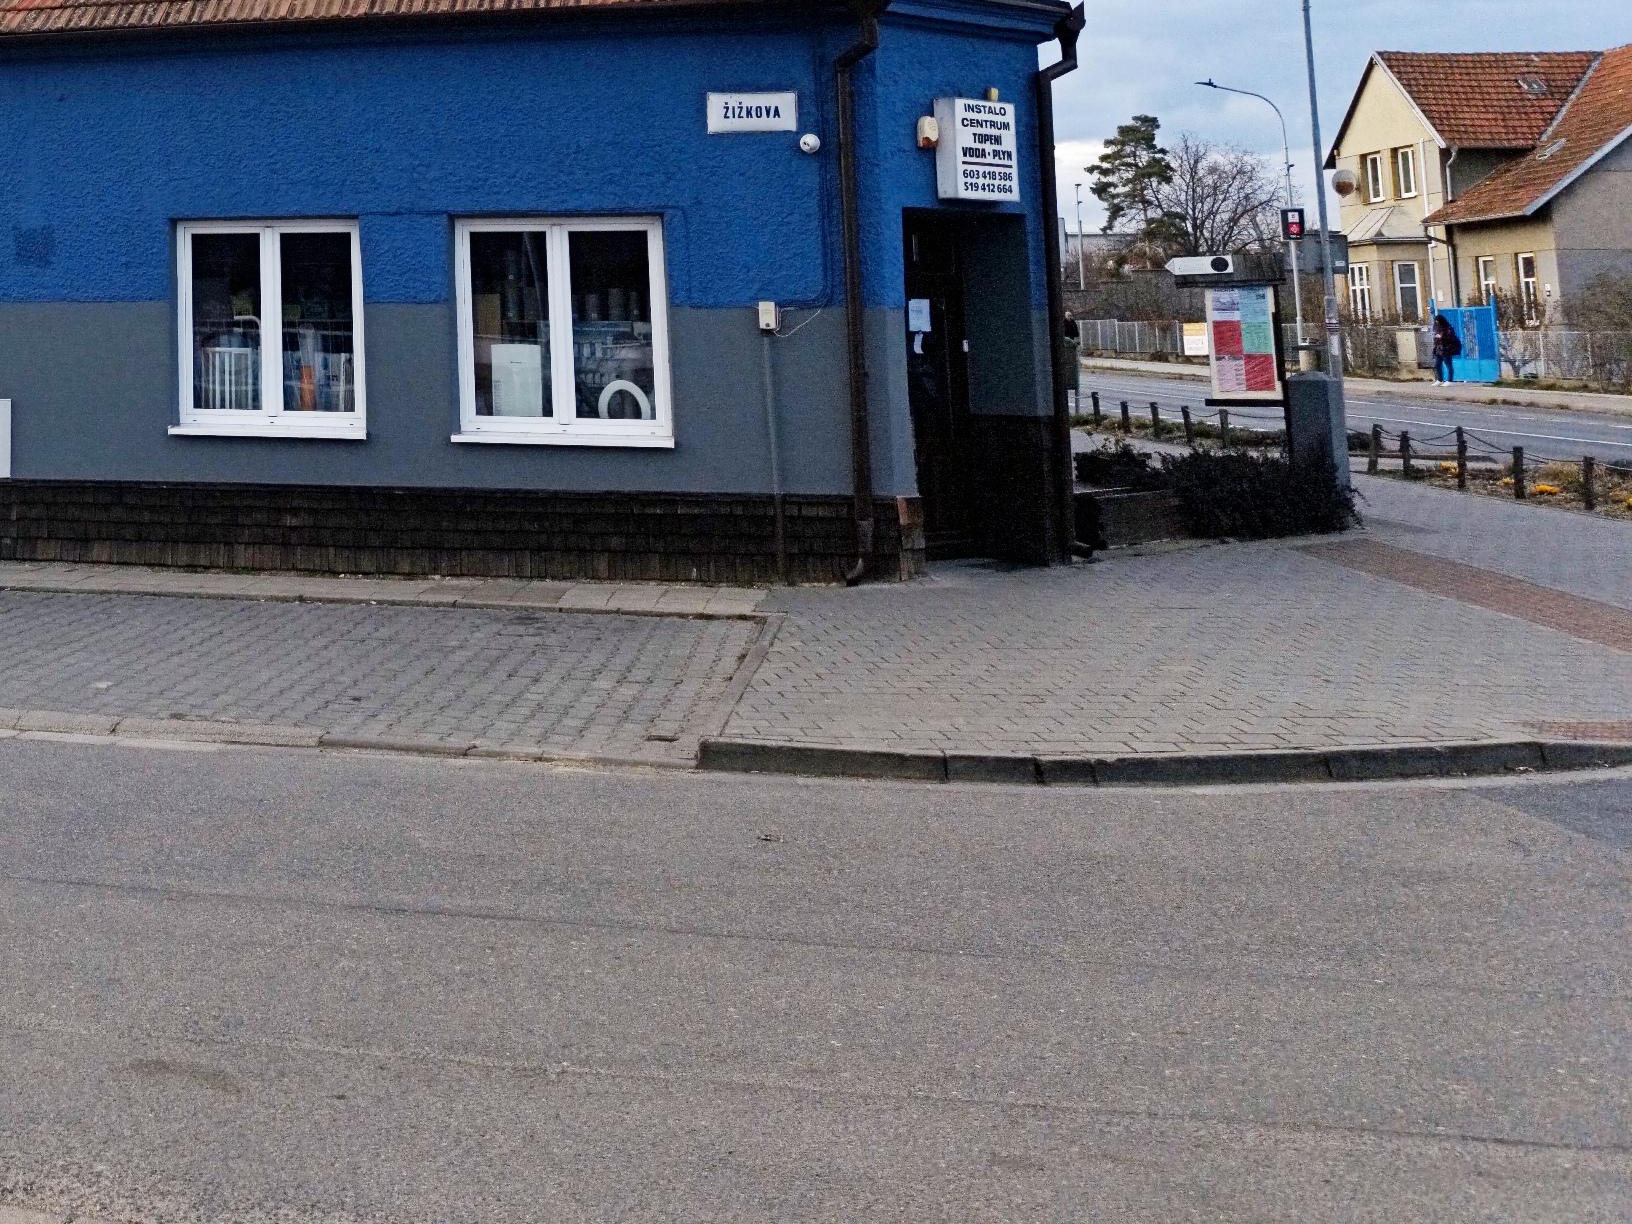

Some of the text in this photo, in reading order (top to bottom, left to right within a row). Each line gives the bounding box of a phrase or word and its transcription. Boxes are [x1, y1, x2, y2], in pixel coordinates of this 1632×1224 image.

[723, 101, 781, 119] ŽIŽKOVA
[964, 103, 1007, 116] INSTALO
[961, 117, 1011, 131] CENTRUM
[972, 132, 1003, 146] TOPENÍ
[962, 146, 1013, 162] VODA PLYN
[963, 168, 1013, 182] 603 418 586
[964, 181, 1013, 194] 519 412 664
